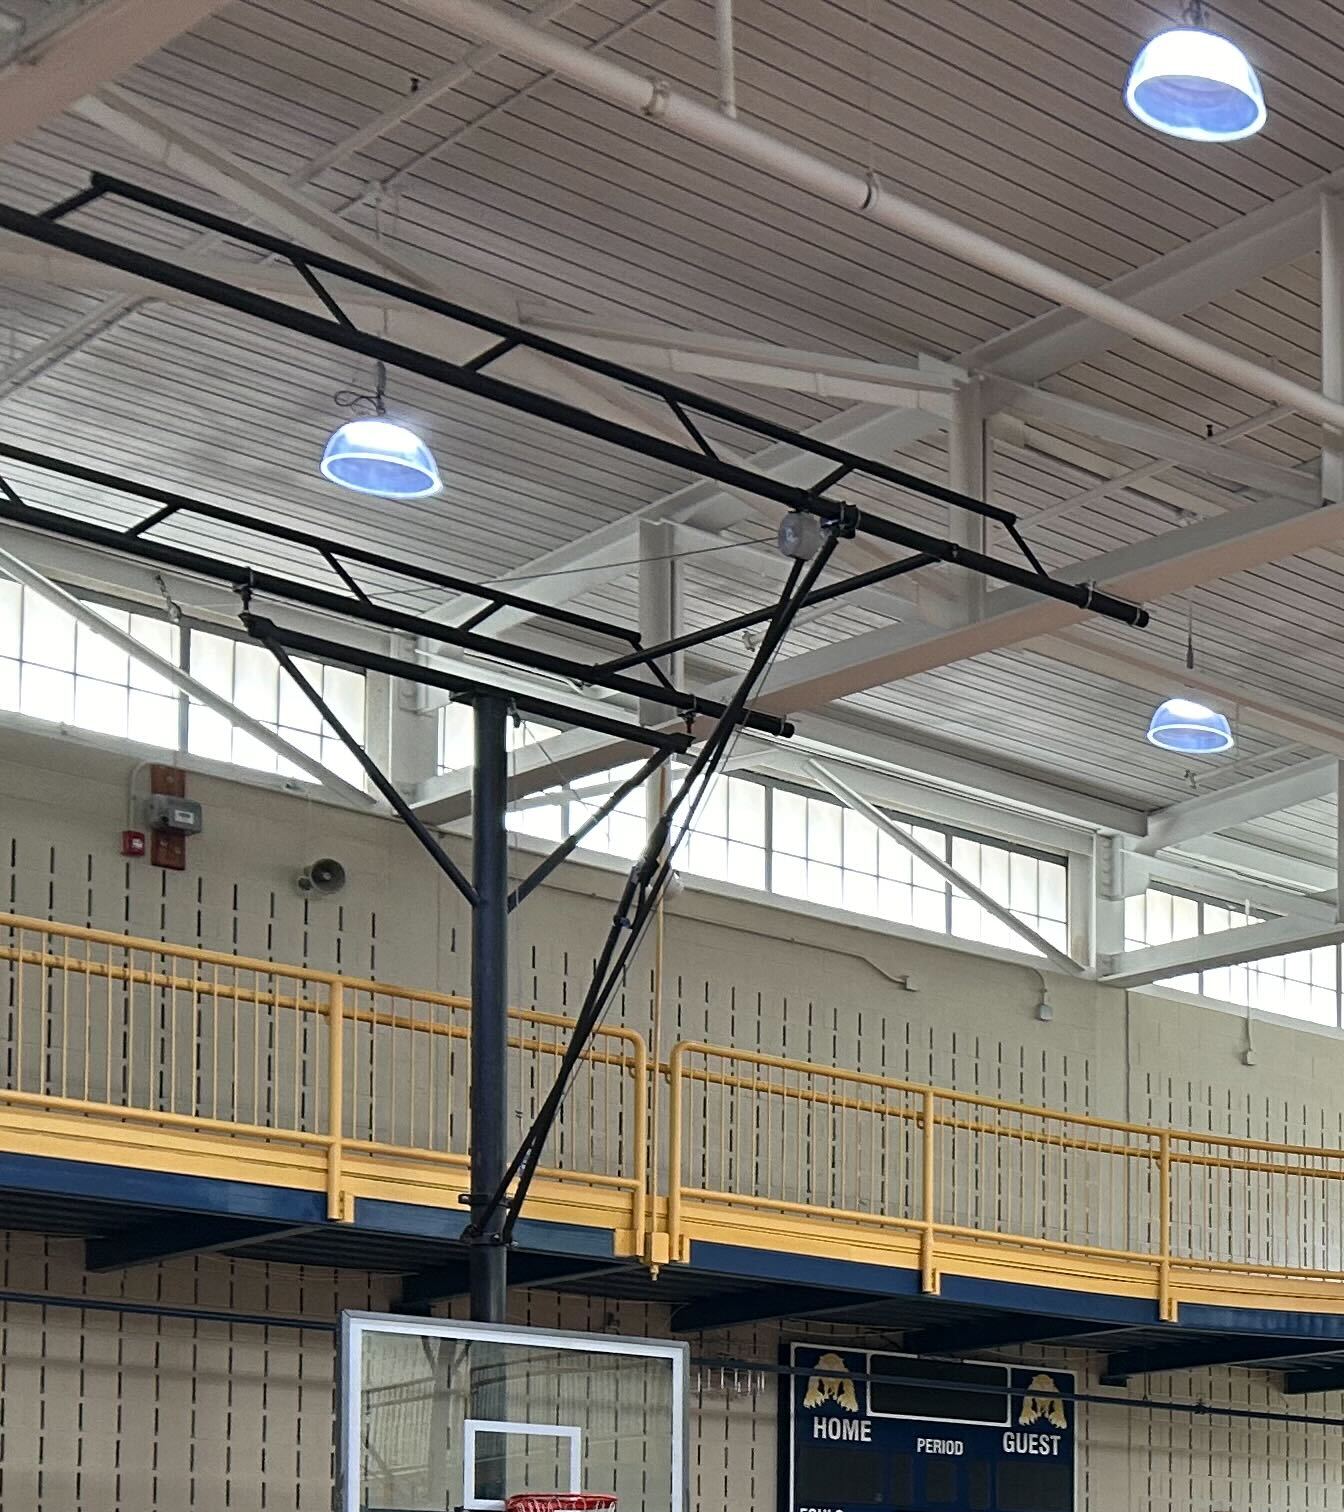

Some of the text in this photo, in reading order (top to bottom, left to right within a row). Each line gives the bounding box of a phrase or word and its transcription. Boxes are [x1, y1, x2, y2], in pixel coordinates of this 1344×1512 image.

[813, 1416, 872, 1442] HOME
[916, 1438, 964, 1455] PERIOD
[1002, 1432, 1061, 1456] GUEST
